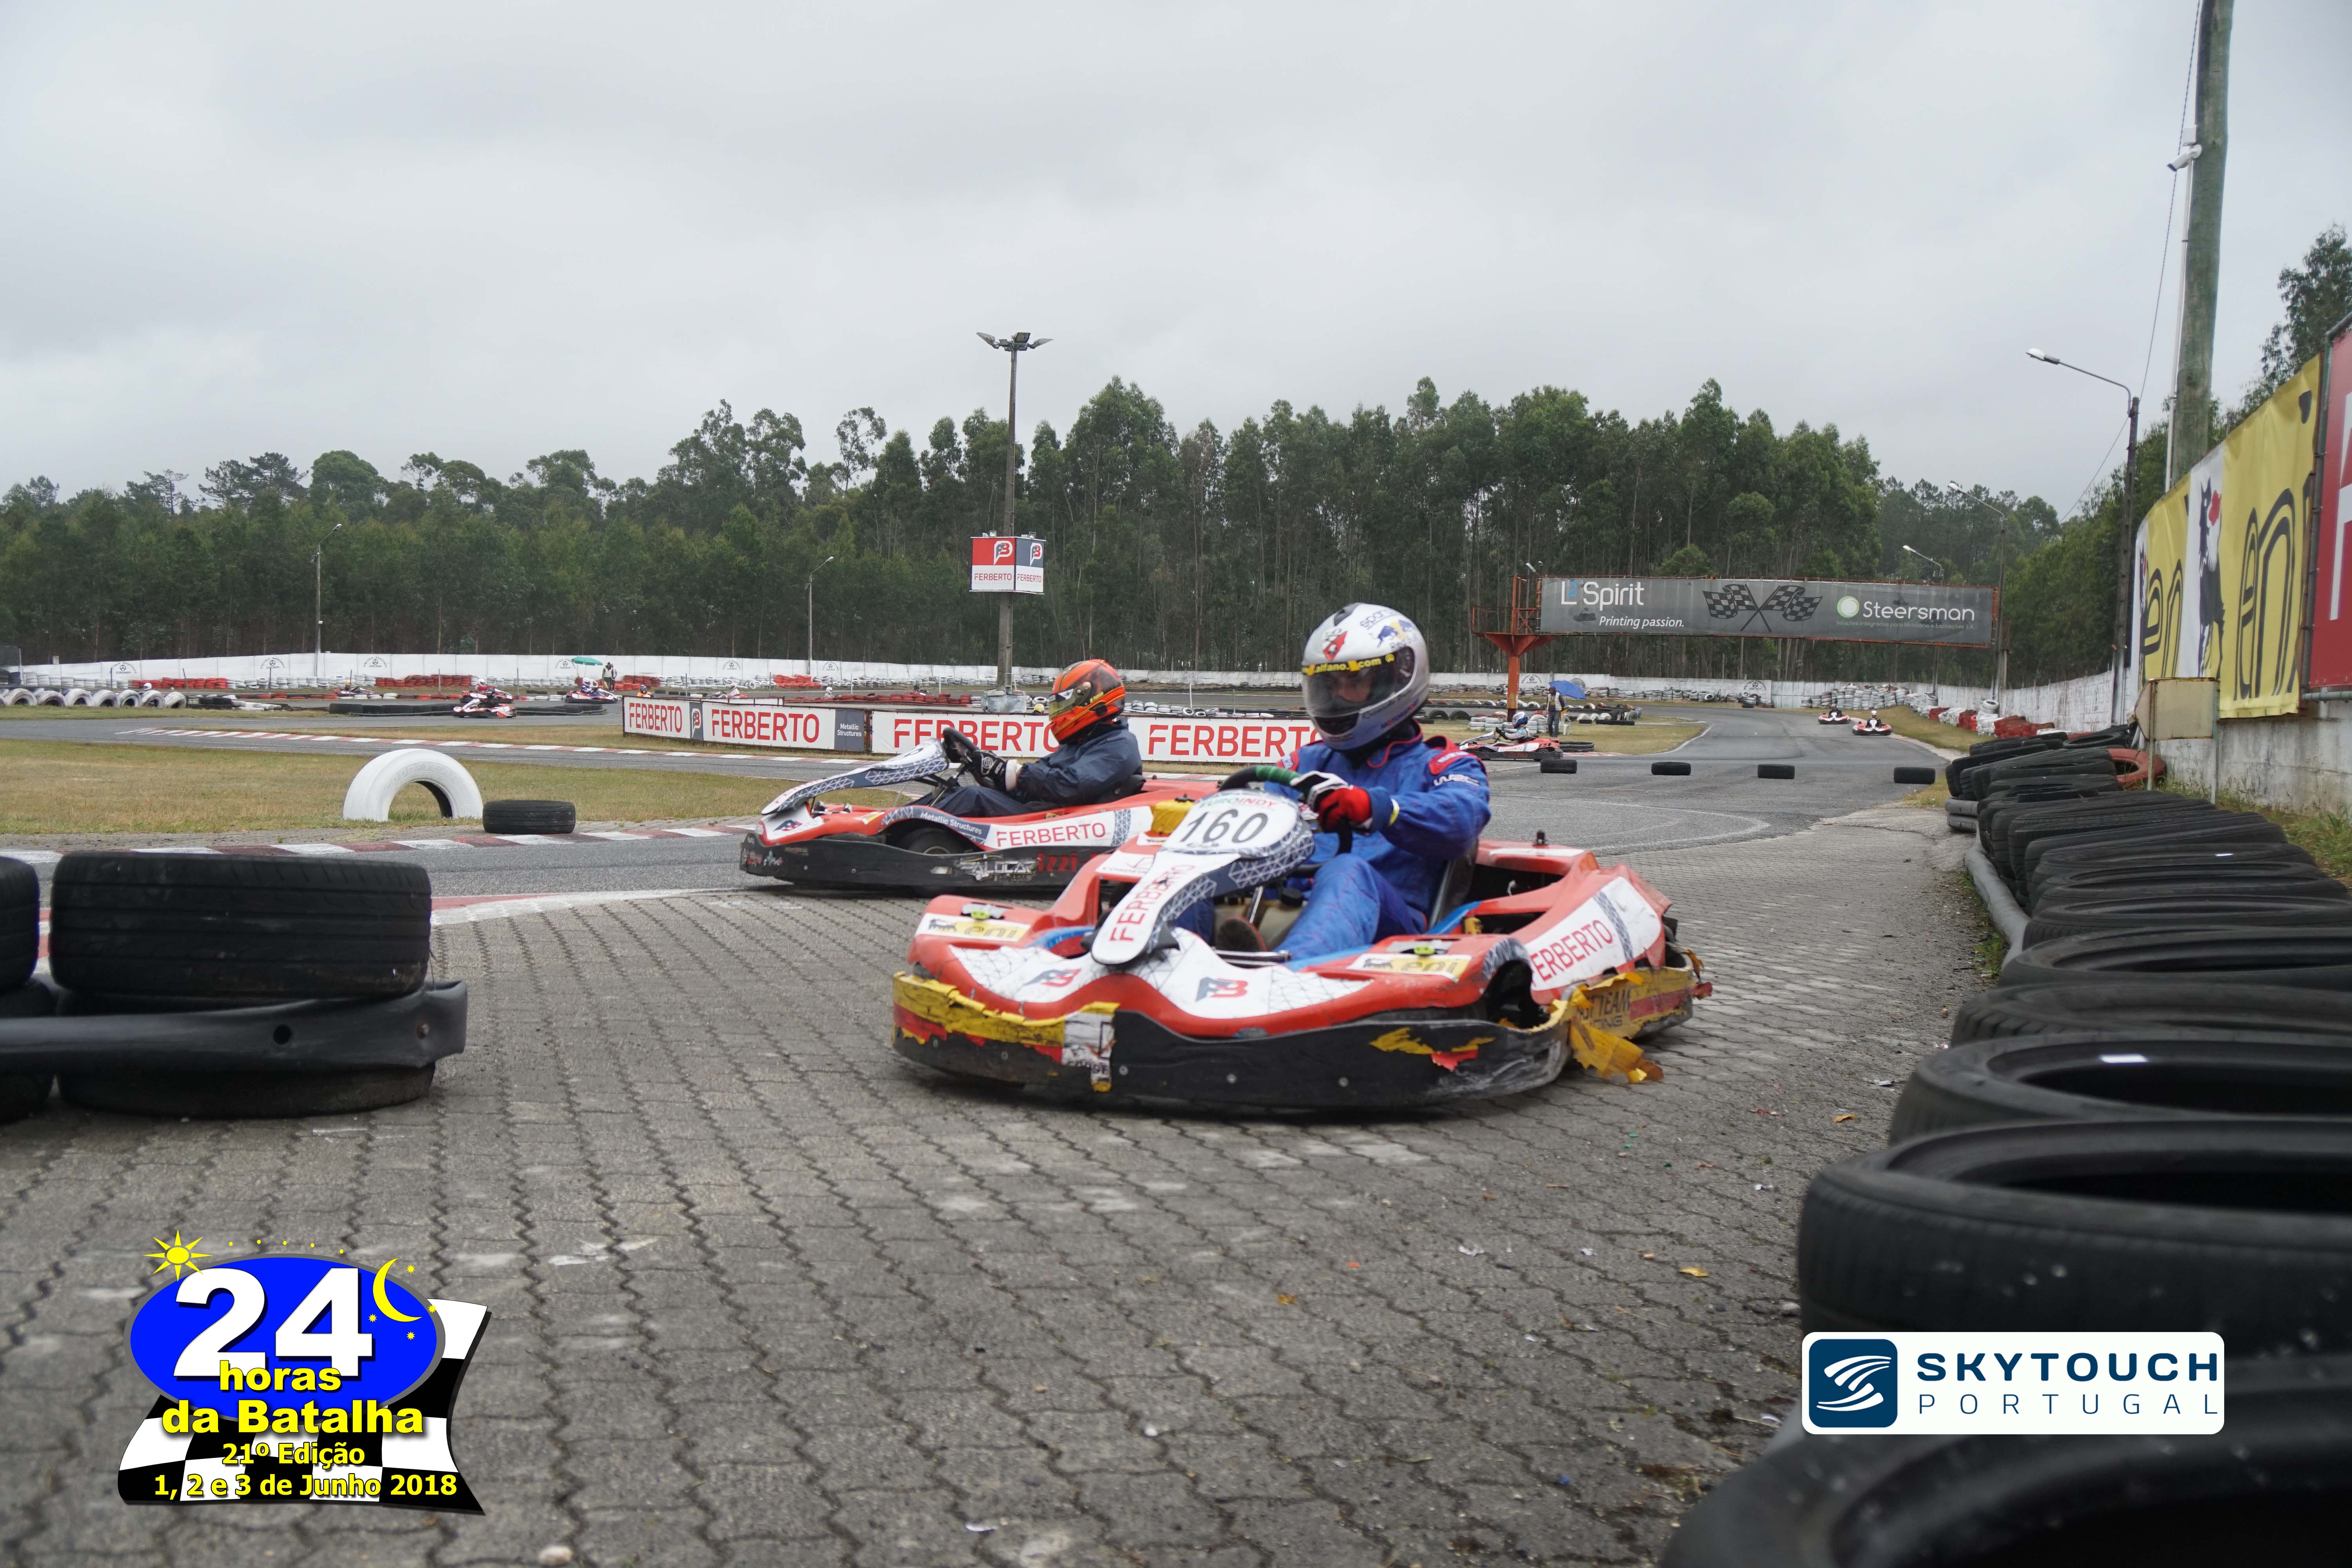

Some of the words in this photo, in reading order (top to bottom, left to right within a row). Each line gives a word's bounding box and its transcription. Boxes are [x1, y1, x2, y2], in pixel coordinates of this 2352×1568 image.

[1017, 573, 1042, 583] FERBERTO
[1583, 581, 1644, 611] Spirit
[1599, 616, 1640, 629] Printing
[1641, 617, 1684, 629] passion.
[1862, 601, 1975, 621] Steersman
[629, 702, 682, 733] FERBERTO
[711, 709, 819, 743] FERBERTO
[920, 811, 949, 824] Metallic
[949, 819, 982, 835] Structures
[997, 822, 1106, 847] FERBERTO
[1180, 809, 1268, 843] 160
[964, 925, 1019, 939] eni
[1401, 956, 1459, 973] eni
[1531, 920, 1613, 987] ERBERTO
